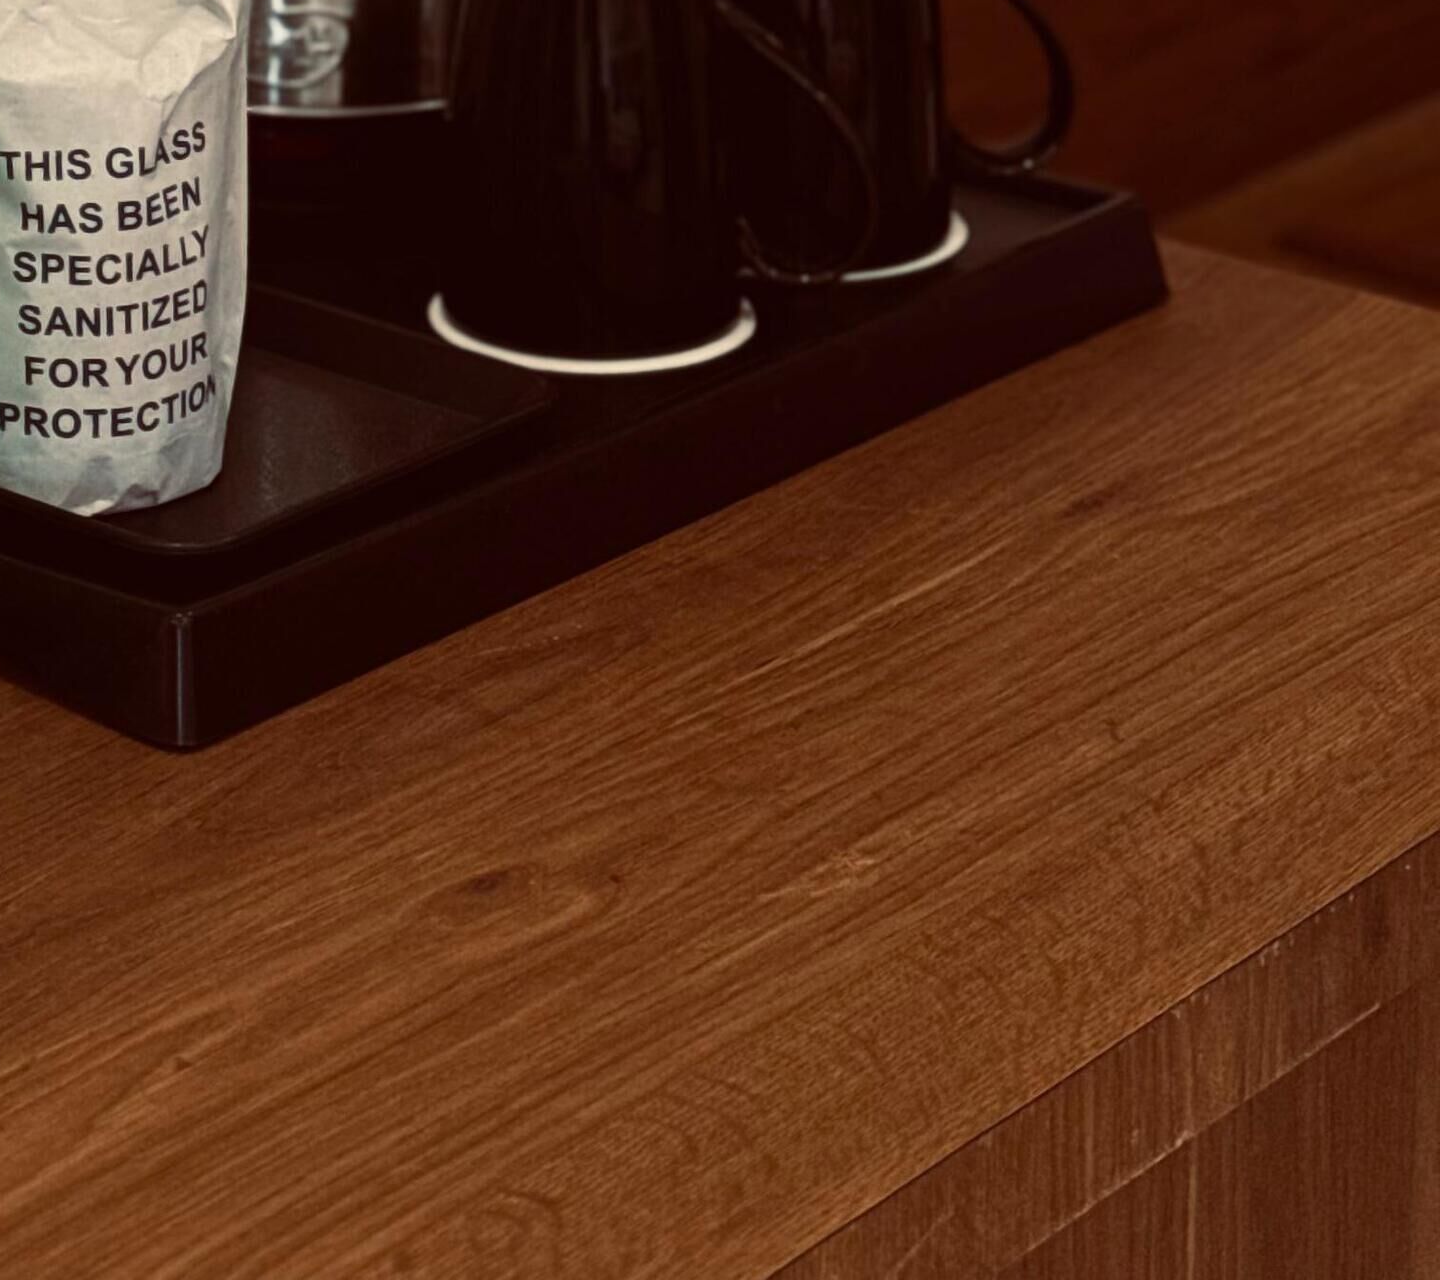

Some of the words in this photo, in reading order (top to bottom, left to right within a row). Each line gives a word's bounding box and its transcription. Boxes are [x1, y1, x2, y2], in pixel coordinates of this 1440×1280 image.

[105, 121, 206, 179] GLASS
[20, 202, 103, 234] HAS
[117, 176, 201, 231] BEEN
[12, 224, 209, 285] SPECIALLY
[18, 279, 207, 337] SANITIZED
[24, 355, 109, 388] FOR
[115, 332, 208, 385] YOUR
